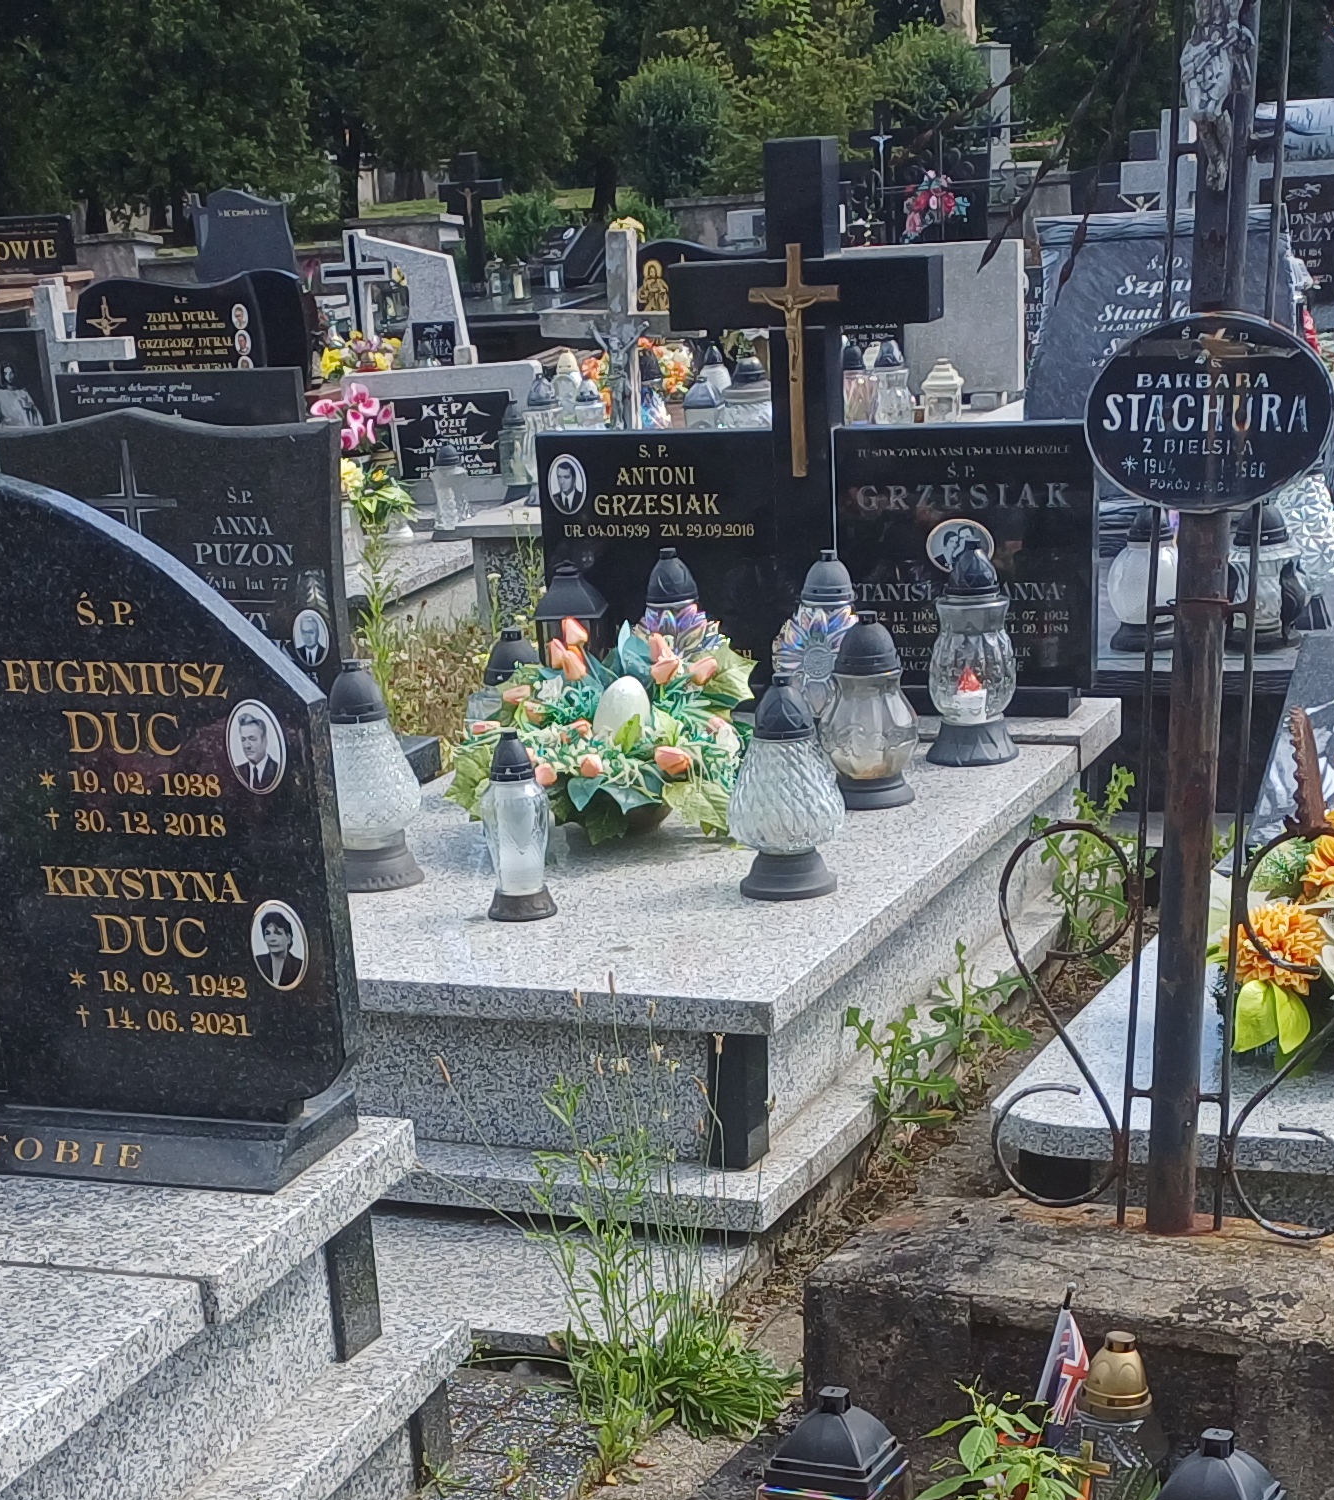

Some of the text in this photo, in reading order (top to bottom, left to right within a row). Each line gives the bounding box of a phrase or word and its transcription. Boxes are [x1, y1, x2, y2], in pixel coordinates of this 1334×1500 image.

[1136, 372, 1269, 389] BARBARA
[1103, 393, 1309, 433] STACHURA
[616, 466, 695, 486] ANTONI
[594, 493, 720, 517] GRZESIAK
[856, 481, 1072, 511] GRZESIAK
[212, 516, 274, 536] ANNA
[192, 542, 294, 567] PUZON
[245, 577, 265, 591] lat
[271, 577, 289, 591] 77
[2, 659, 229, 699] EUGENIUSZ
[62, 710, 181, 756] DUC
[69, 770, 222, 798] 19. 02. 1938
[74, 809, 227, 838] 30. 12. 2018
[40, 865, 249, 905] KRYSTYNA
[91, 914, 208, 958] DUC
[98, 970, 248, 999] 18. 02. 1942
[103, 1006, 253, 1037] 14. 06. 2021
